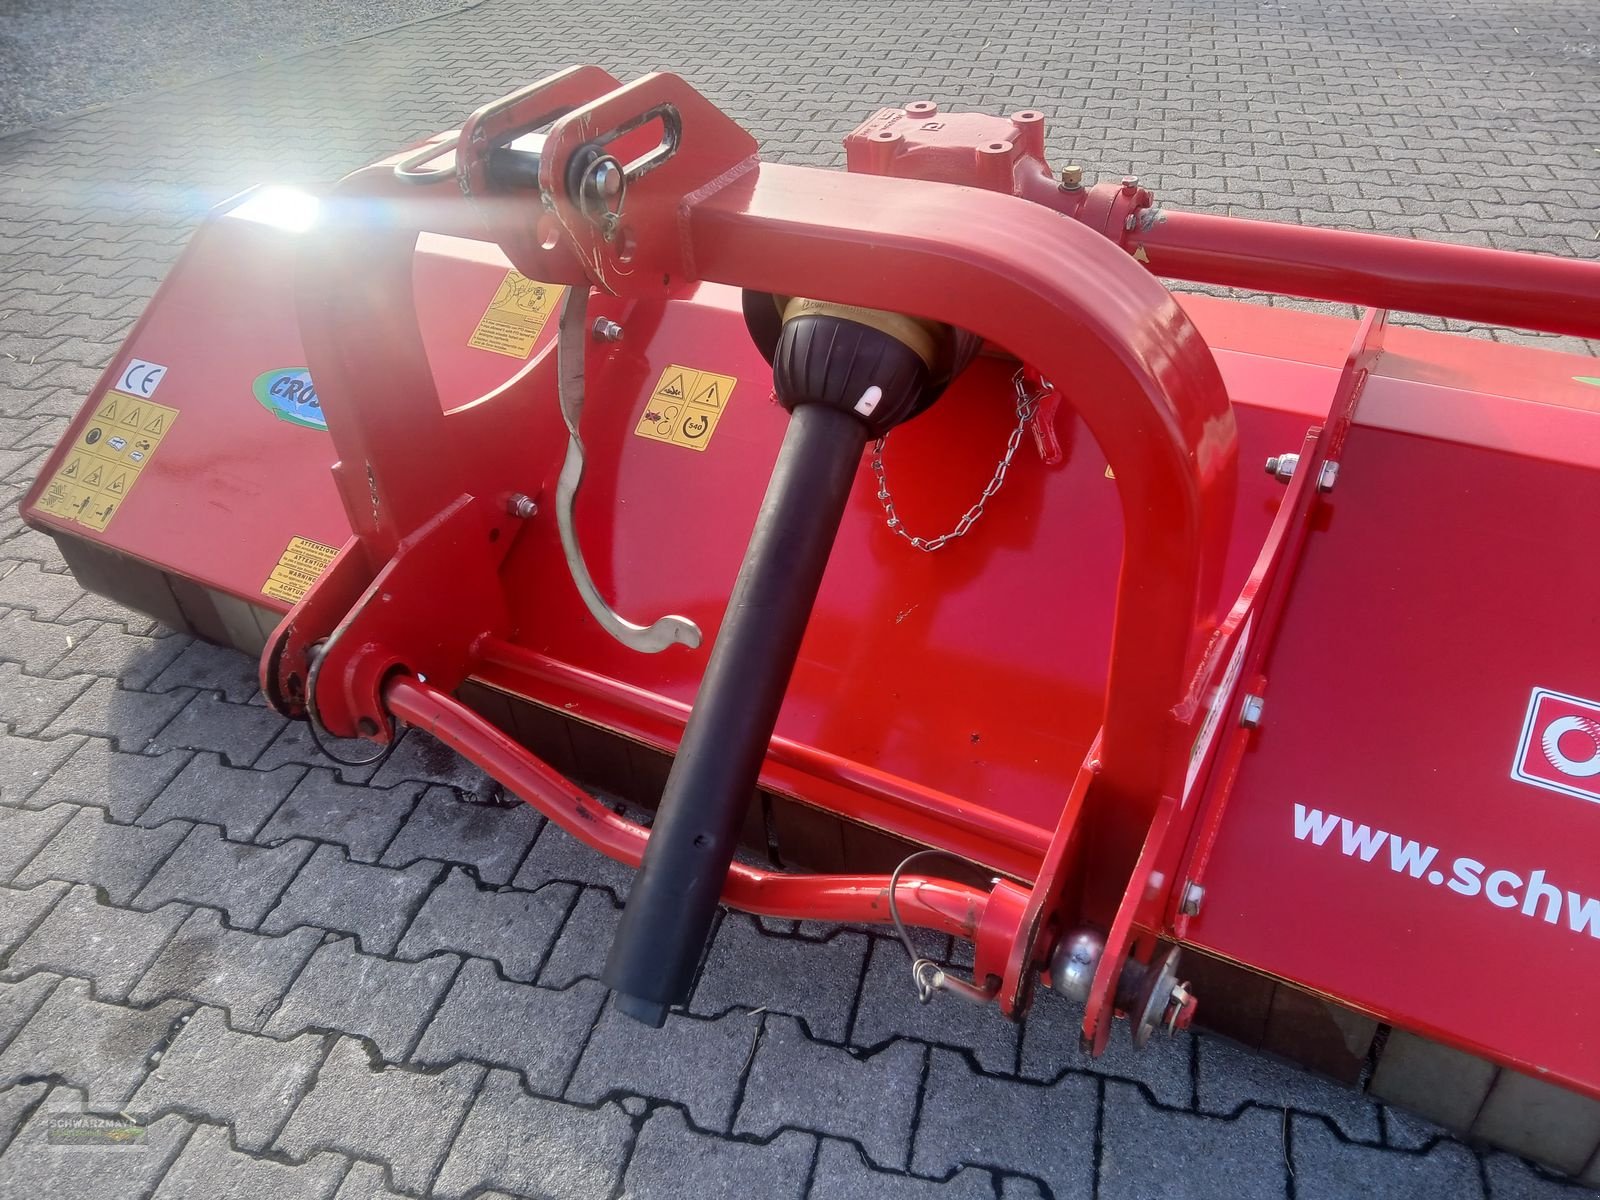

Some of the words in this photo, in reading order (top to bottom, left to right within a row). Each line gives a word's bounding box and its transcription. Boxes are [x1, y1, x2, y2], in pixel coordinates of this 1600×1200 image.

[125, 364, 161, 394] CE
[688, 422, 703, 431] 540
[300, 540, 338, 556] ATTENZIONE
